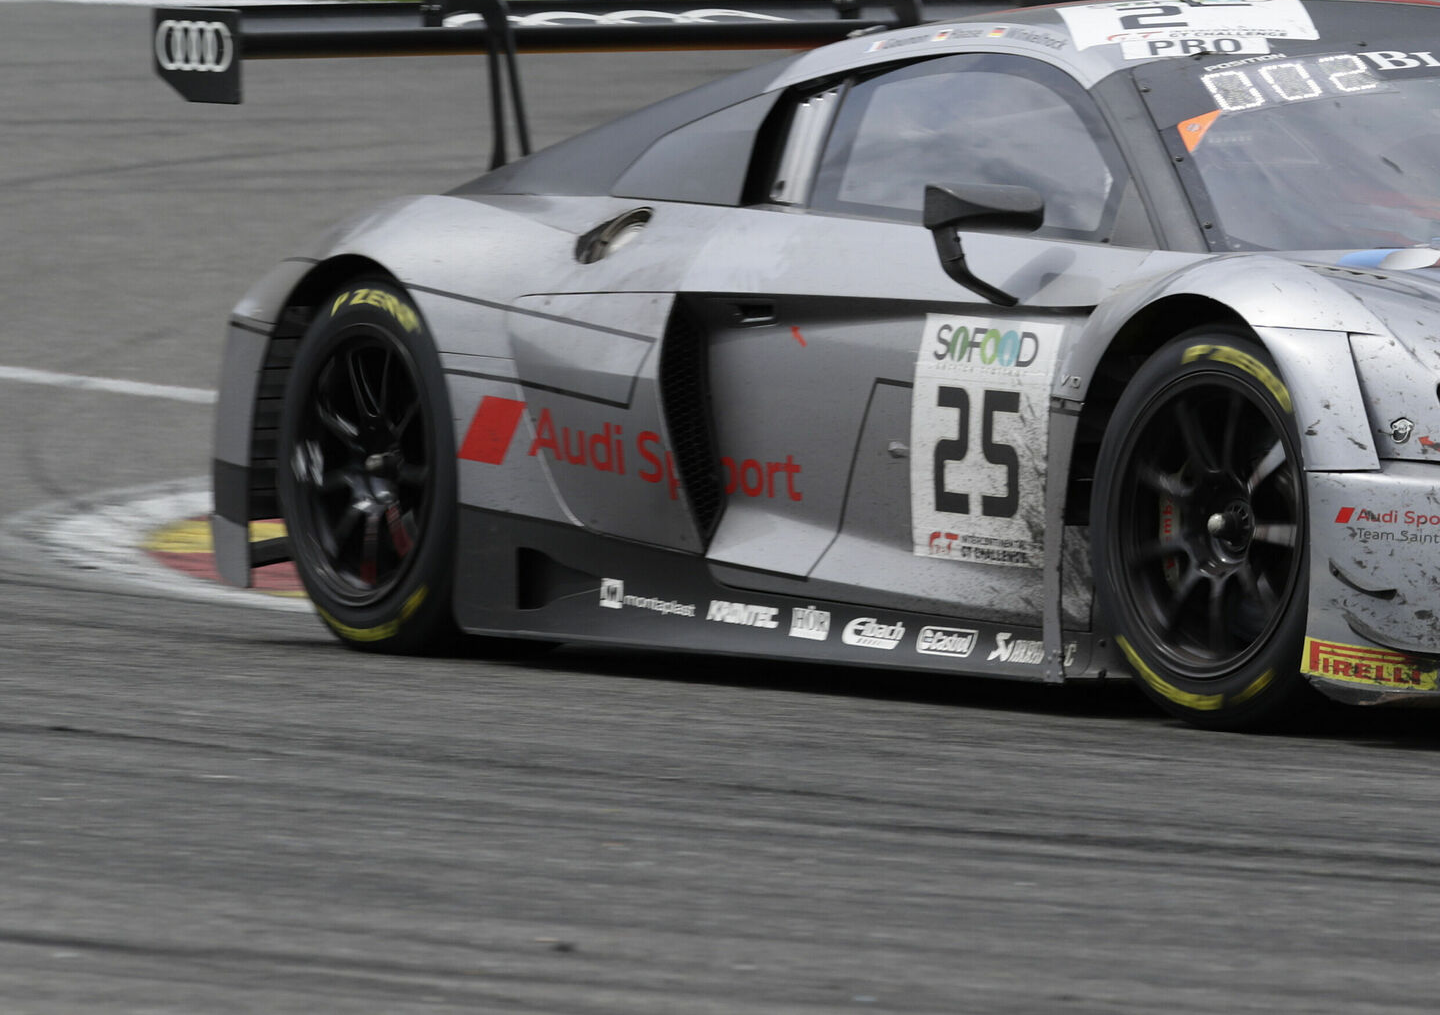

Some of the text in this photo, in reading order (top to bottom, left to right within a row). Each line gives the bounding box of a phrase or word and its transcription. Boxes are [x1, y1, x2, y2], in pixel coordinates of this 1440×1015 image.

[1194, 30, 1289, 38] CHALLENGE
[1149, 37, 1243, 56] PRO
[1203, 52, 1287, 73] POSITION
[1200, 53, 1380, 112] 002
[528, 407, 626, 476] Audi
[933, 385, 1021, 519] 25
[1356, 508, 1399, 524] Audi
[1356, 527, 1395, 541] Team
[1309, 640, 1424, 685] PIRELLI
